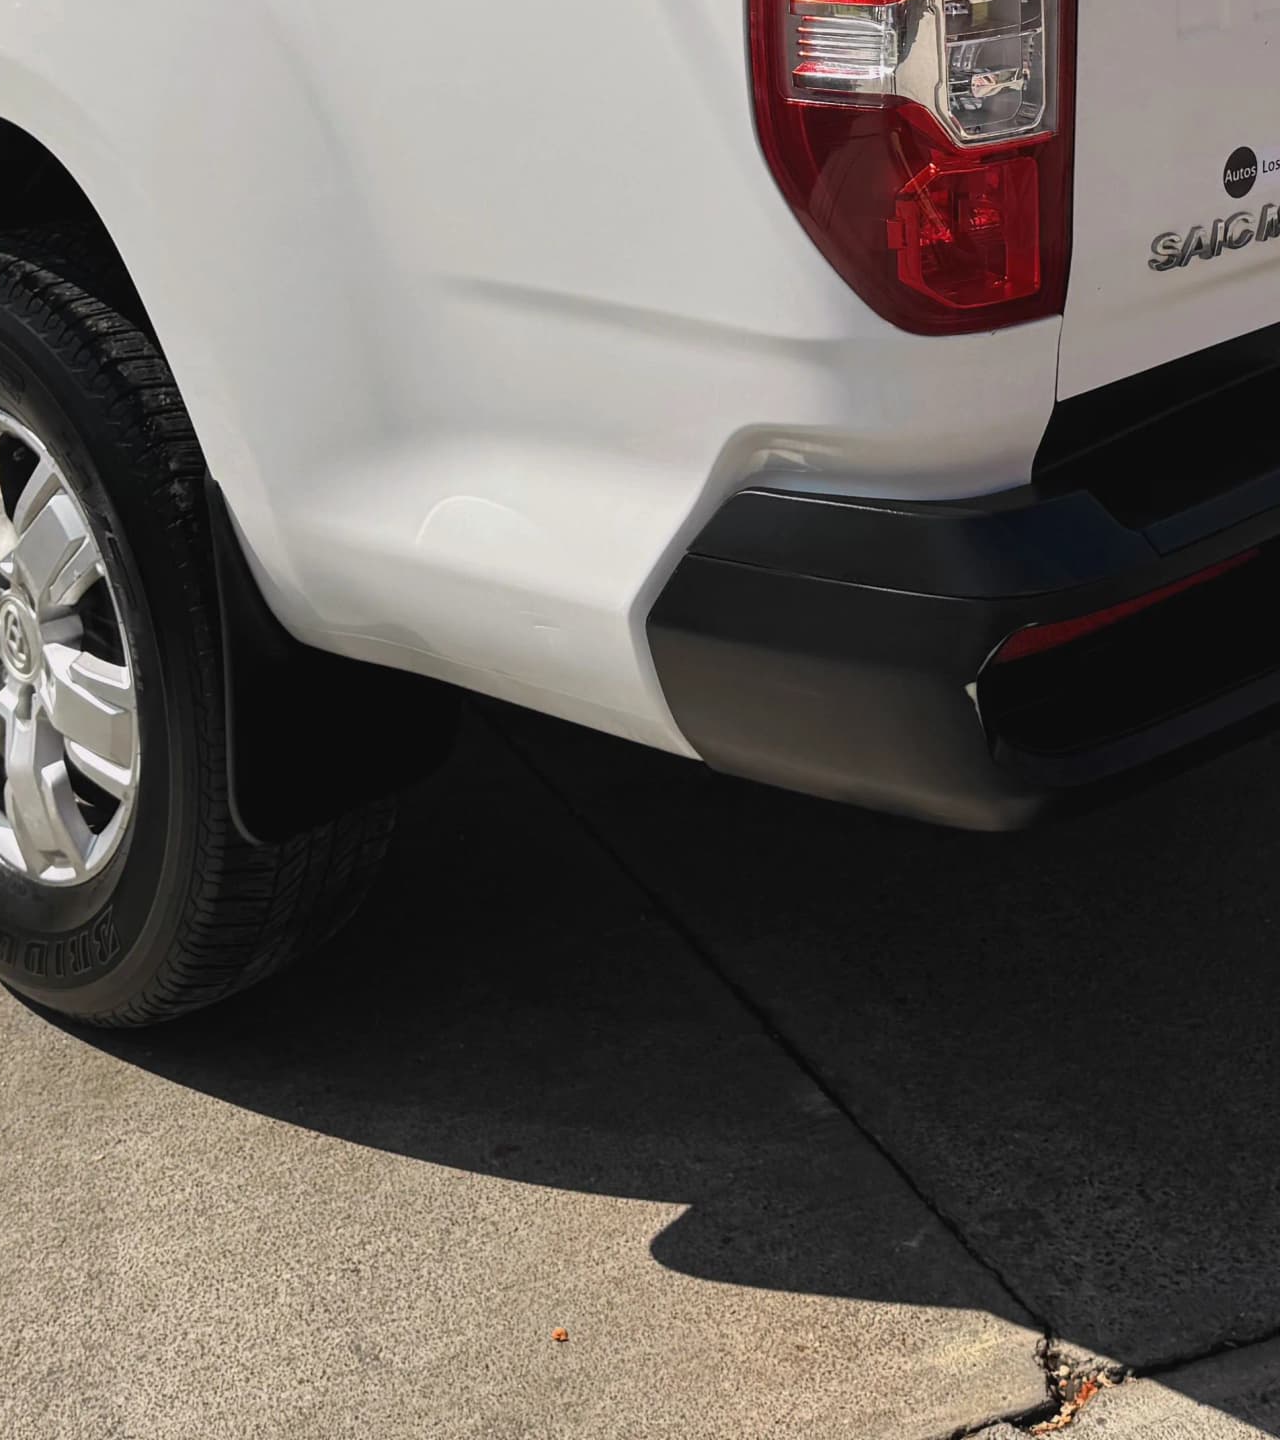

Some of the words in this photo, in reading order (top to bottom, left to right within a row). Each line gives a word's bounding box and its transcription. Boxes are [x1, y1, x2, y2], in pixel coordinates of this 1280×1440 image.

[1224, 163, 1257, 184] Autos
[1262, 158, 1280, 174] Los
[1148, 211, 1256, 271] SAIC
